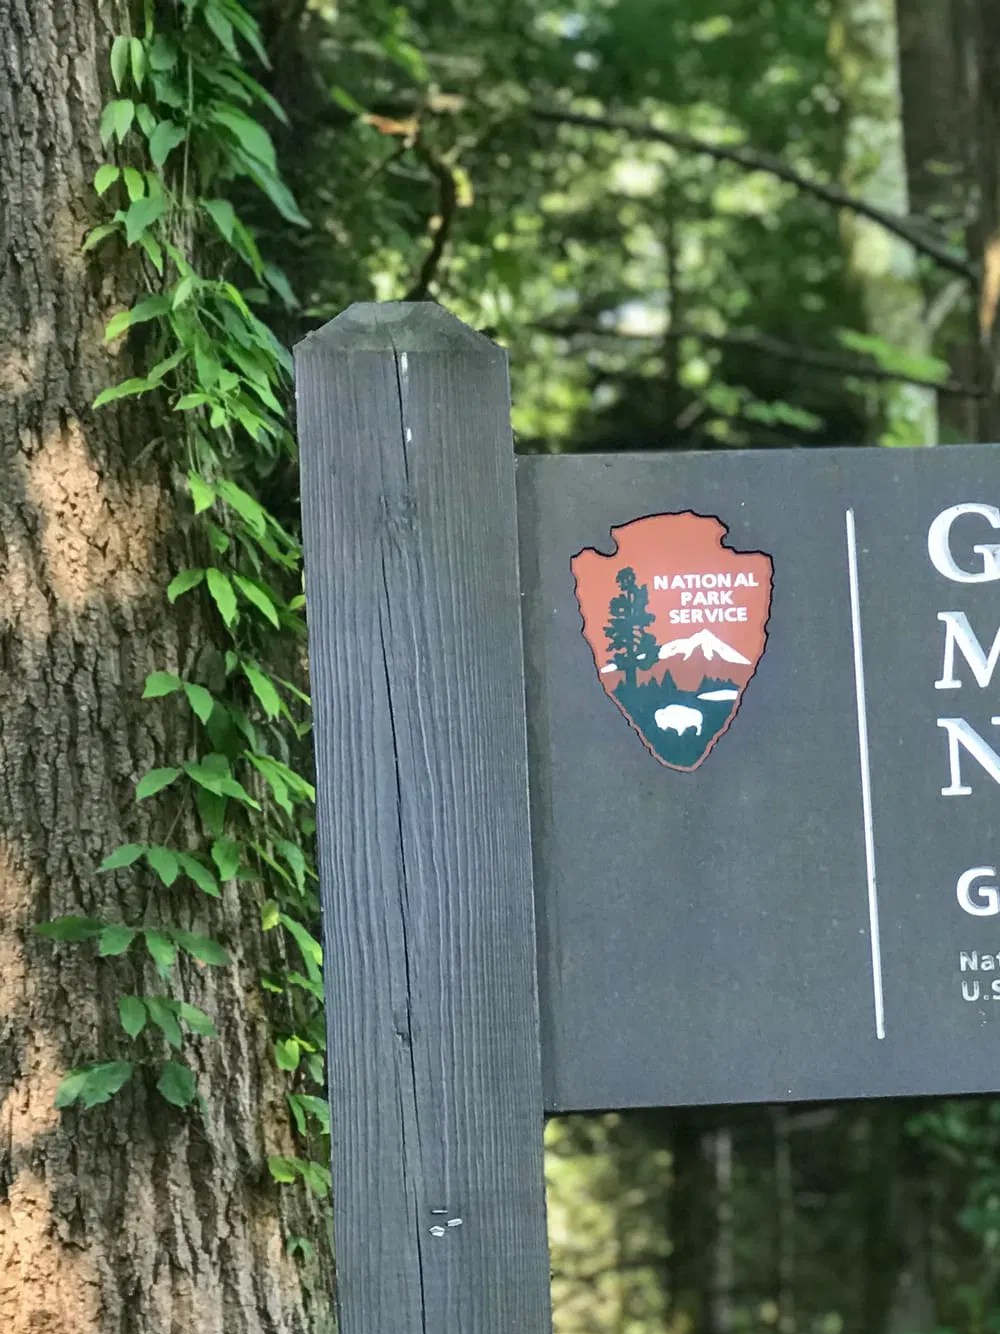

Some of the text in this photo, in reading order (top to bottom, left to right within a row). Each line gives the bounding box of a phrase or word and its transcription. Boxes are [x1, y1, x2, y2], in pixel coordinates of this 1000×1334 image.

[653, 572, 759, 590] NATIONAL
[680, 590, 733, 606] PARK
[668, 607, 748, 624] SERVICE
